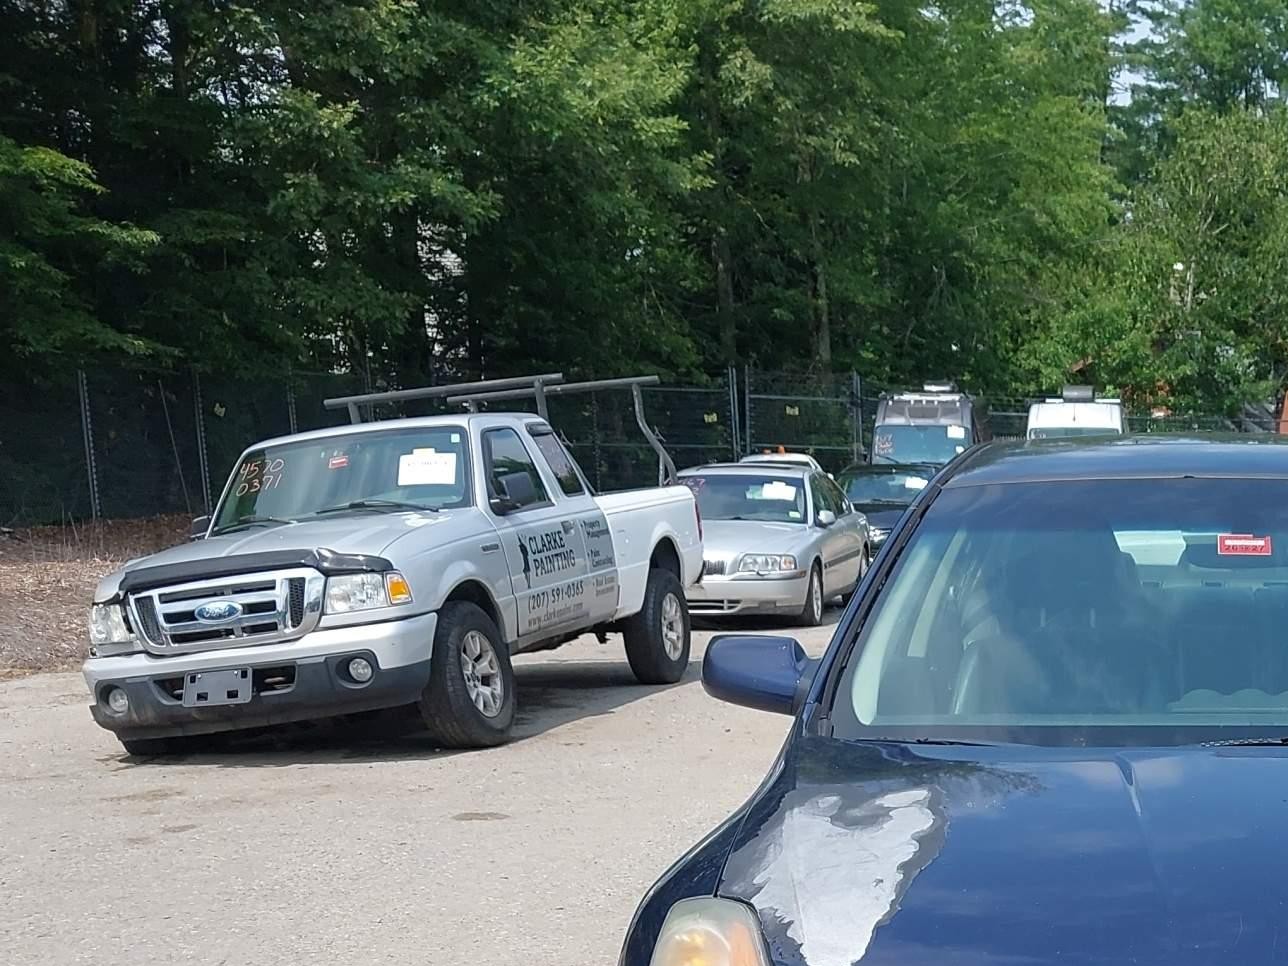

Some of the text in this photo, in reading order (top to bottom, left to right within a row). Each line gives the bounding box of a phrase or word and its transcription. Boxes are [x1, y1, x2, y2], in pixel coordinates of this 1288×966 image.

[240, 459, 284, 480] 4570
[236, 473, 282, 496] 0371
[528, 531, 566, 555] CLARKE
[533, 549, 576, 577] PAINTING
[528, 592, 549, 613] (207)
[551, 580, 584, 603] 591-0365
